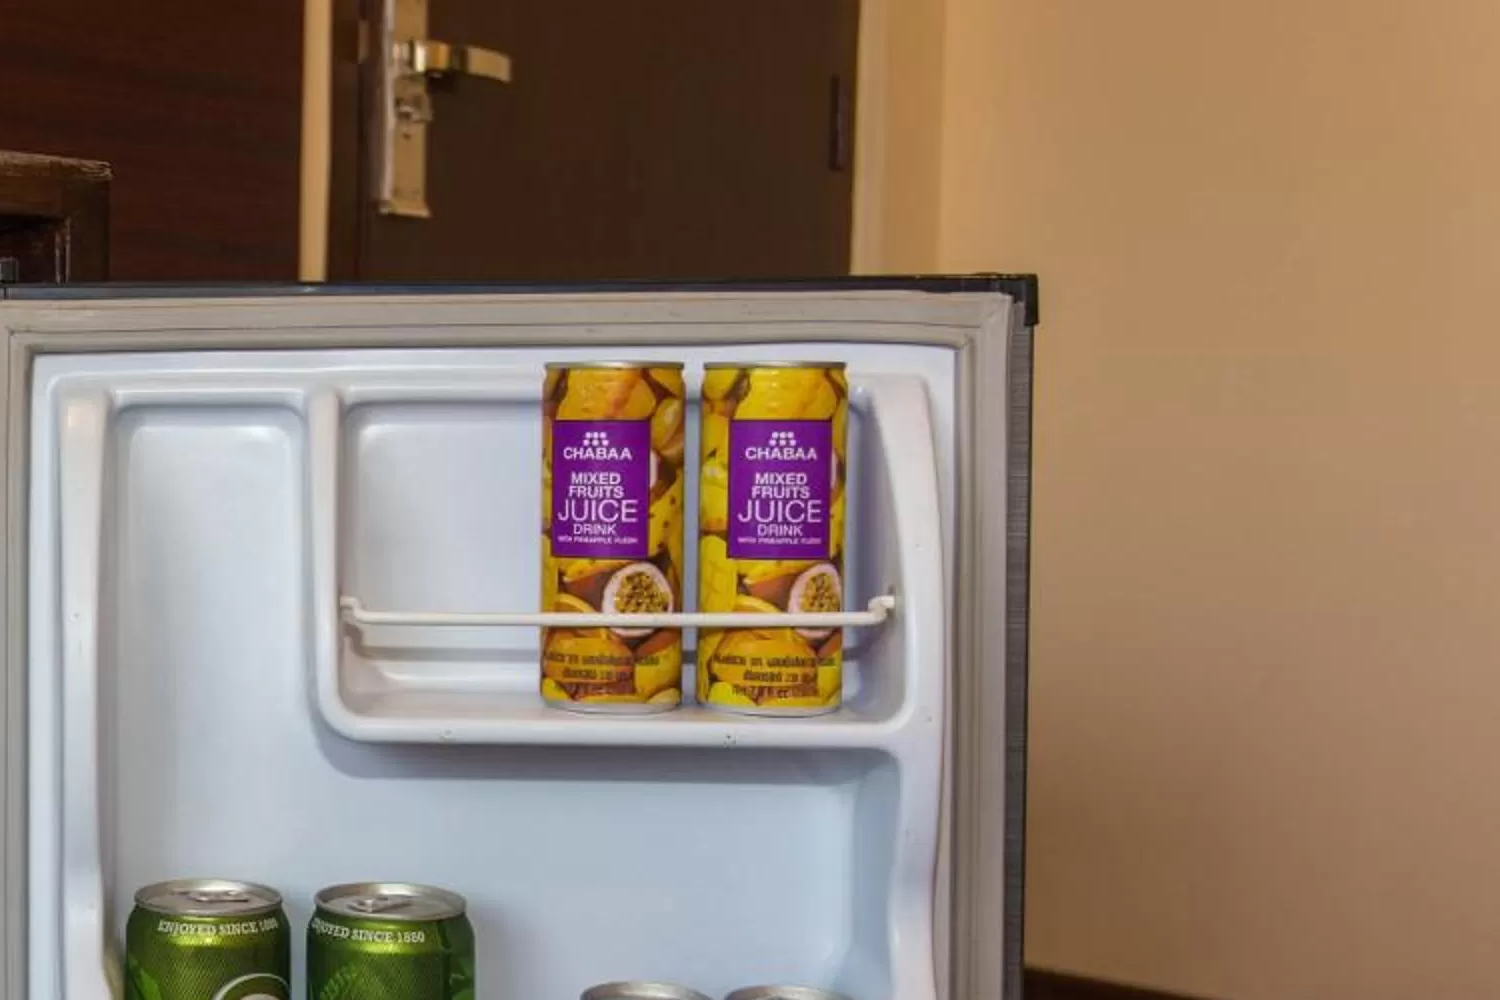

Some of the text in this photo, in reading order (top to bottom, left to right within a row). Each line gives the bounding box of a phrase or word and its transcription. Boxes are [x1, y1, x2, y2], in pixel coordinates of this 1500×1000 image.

[563, 447, 632, 460] CHABAA
[745, 447, 817, 460] CHABAA
[571, 472, 621, 485] MIXED
[755, 472, 807, 485] MIXED
[569, 485, 624, 498] FRUITS
[752, 485, 810, 498] FRUITS
[558, 499, 639, 522] JUICE
[737, 499, 822, 522] JUICE
[573, 523, 617, 535] DRINK
[757, 523, 804, 536] DRINK
[157, 919, 217, 936] ENJOYED
[219, 921, 258, 935] SINCE
[351, 928, 394, 942] SINCE
